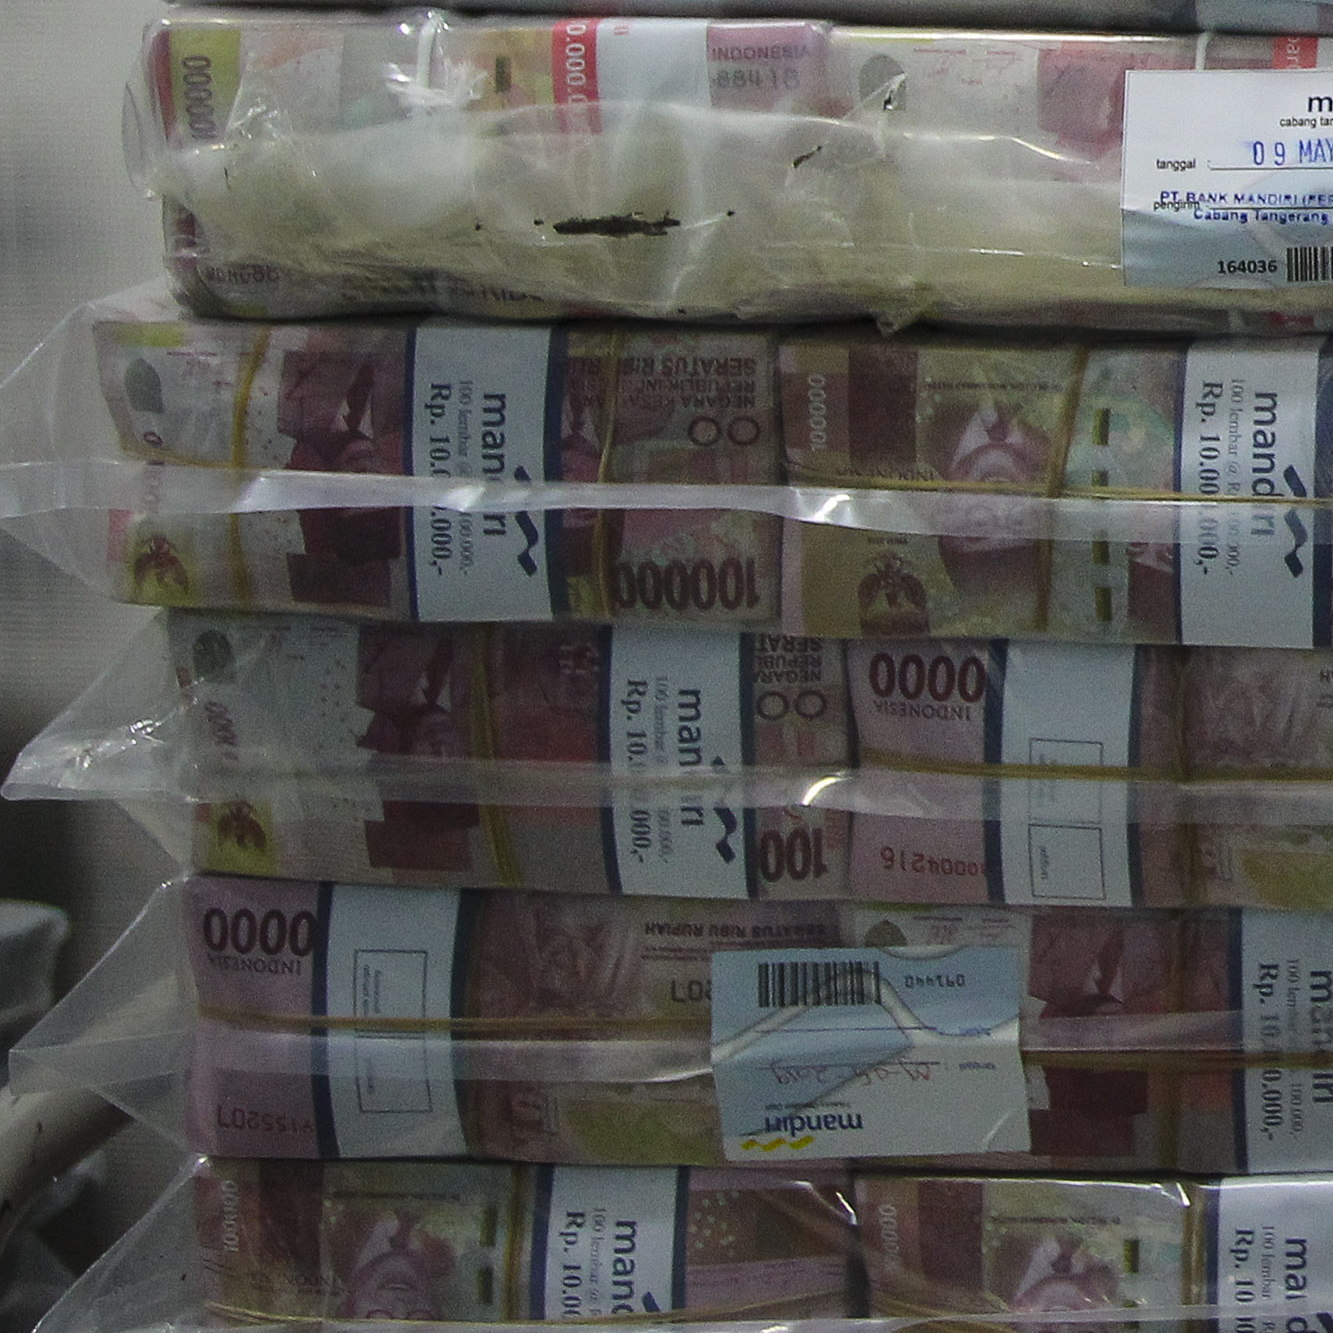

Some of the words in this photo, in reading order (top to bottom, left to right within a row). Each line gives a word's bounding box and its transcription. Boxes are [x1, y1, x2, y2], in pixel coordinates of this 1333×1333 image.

[1279, 116, 1318, 128] cabang
[1156, 157, 1197, 171] tanggal
[1186, 192, 1228, 205] BANK
[1233, 193, 1298, 206] MANDIRI
[1216, 259, 1278, 276] 164036
[425, 382, 454, 426] Rp.
[1197, 381, 1224, 424] Rp.
[1229, 377, 1244, 404] 100
[1227, 408, 1244, 458] lembar
[621, 678, 650, 721] Rp.
[1253, 962, 1281, 1005] Rp.
[560, 1210, 585, 1253] Rp.
[1231, 1228, 1257, 1270] Rp.
